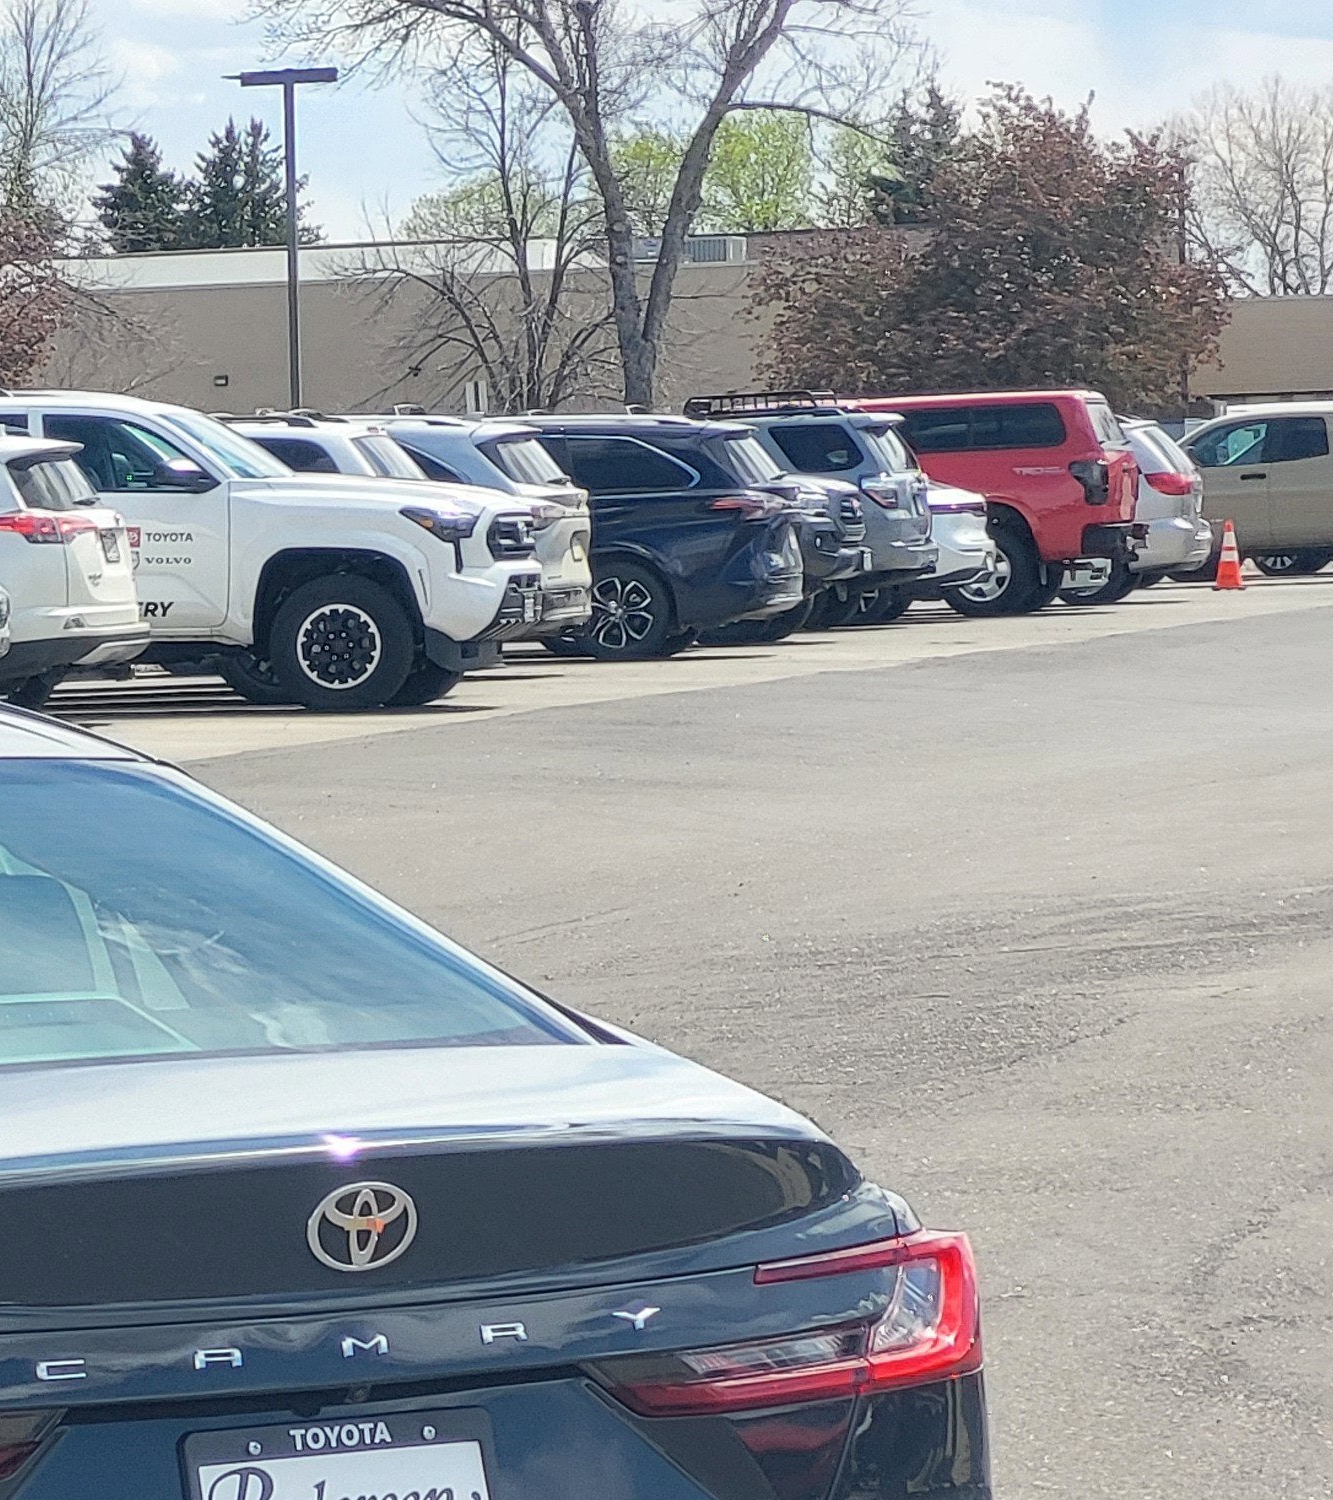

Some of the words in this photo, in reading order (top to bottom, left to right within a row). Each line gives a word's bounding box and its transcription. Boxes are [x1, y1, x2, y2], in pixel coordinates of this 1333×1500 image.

[145, 532, 194, 543] TOYOTA
[144, 556, 192, 565] VOLVO
[35, 1307, 661, 1381] CAMRY
[289, 1421, 392, 1451] TOYOTA
